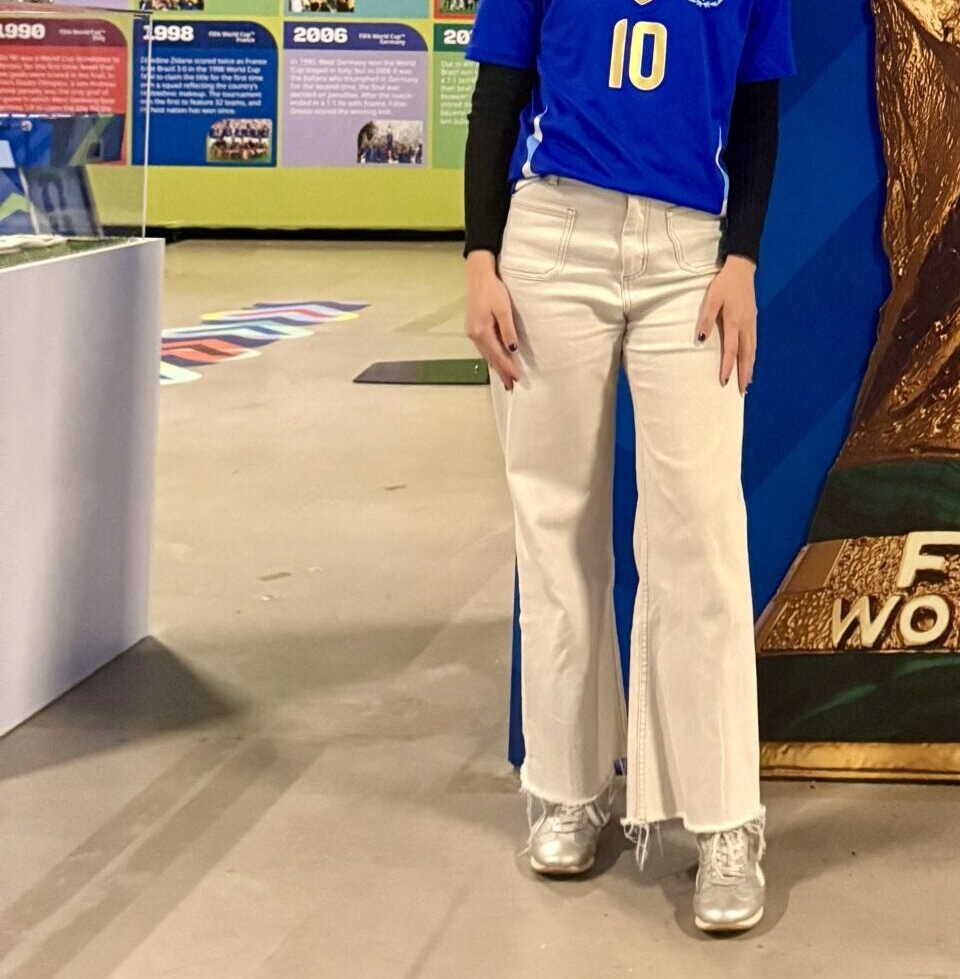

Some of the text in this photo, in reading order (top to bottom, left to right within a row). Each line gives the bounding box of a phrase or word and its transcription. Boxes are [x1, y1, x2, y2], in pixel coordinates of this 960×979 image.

[143, 25, 194, 42] 1998
[293, 27, 348, 43] 2006
[608, 18, 668, 91] 10
